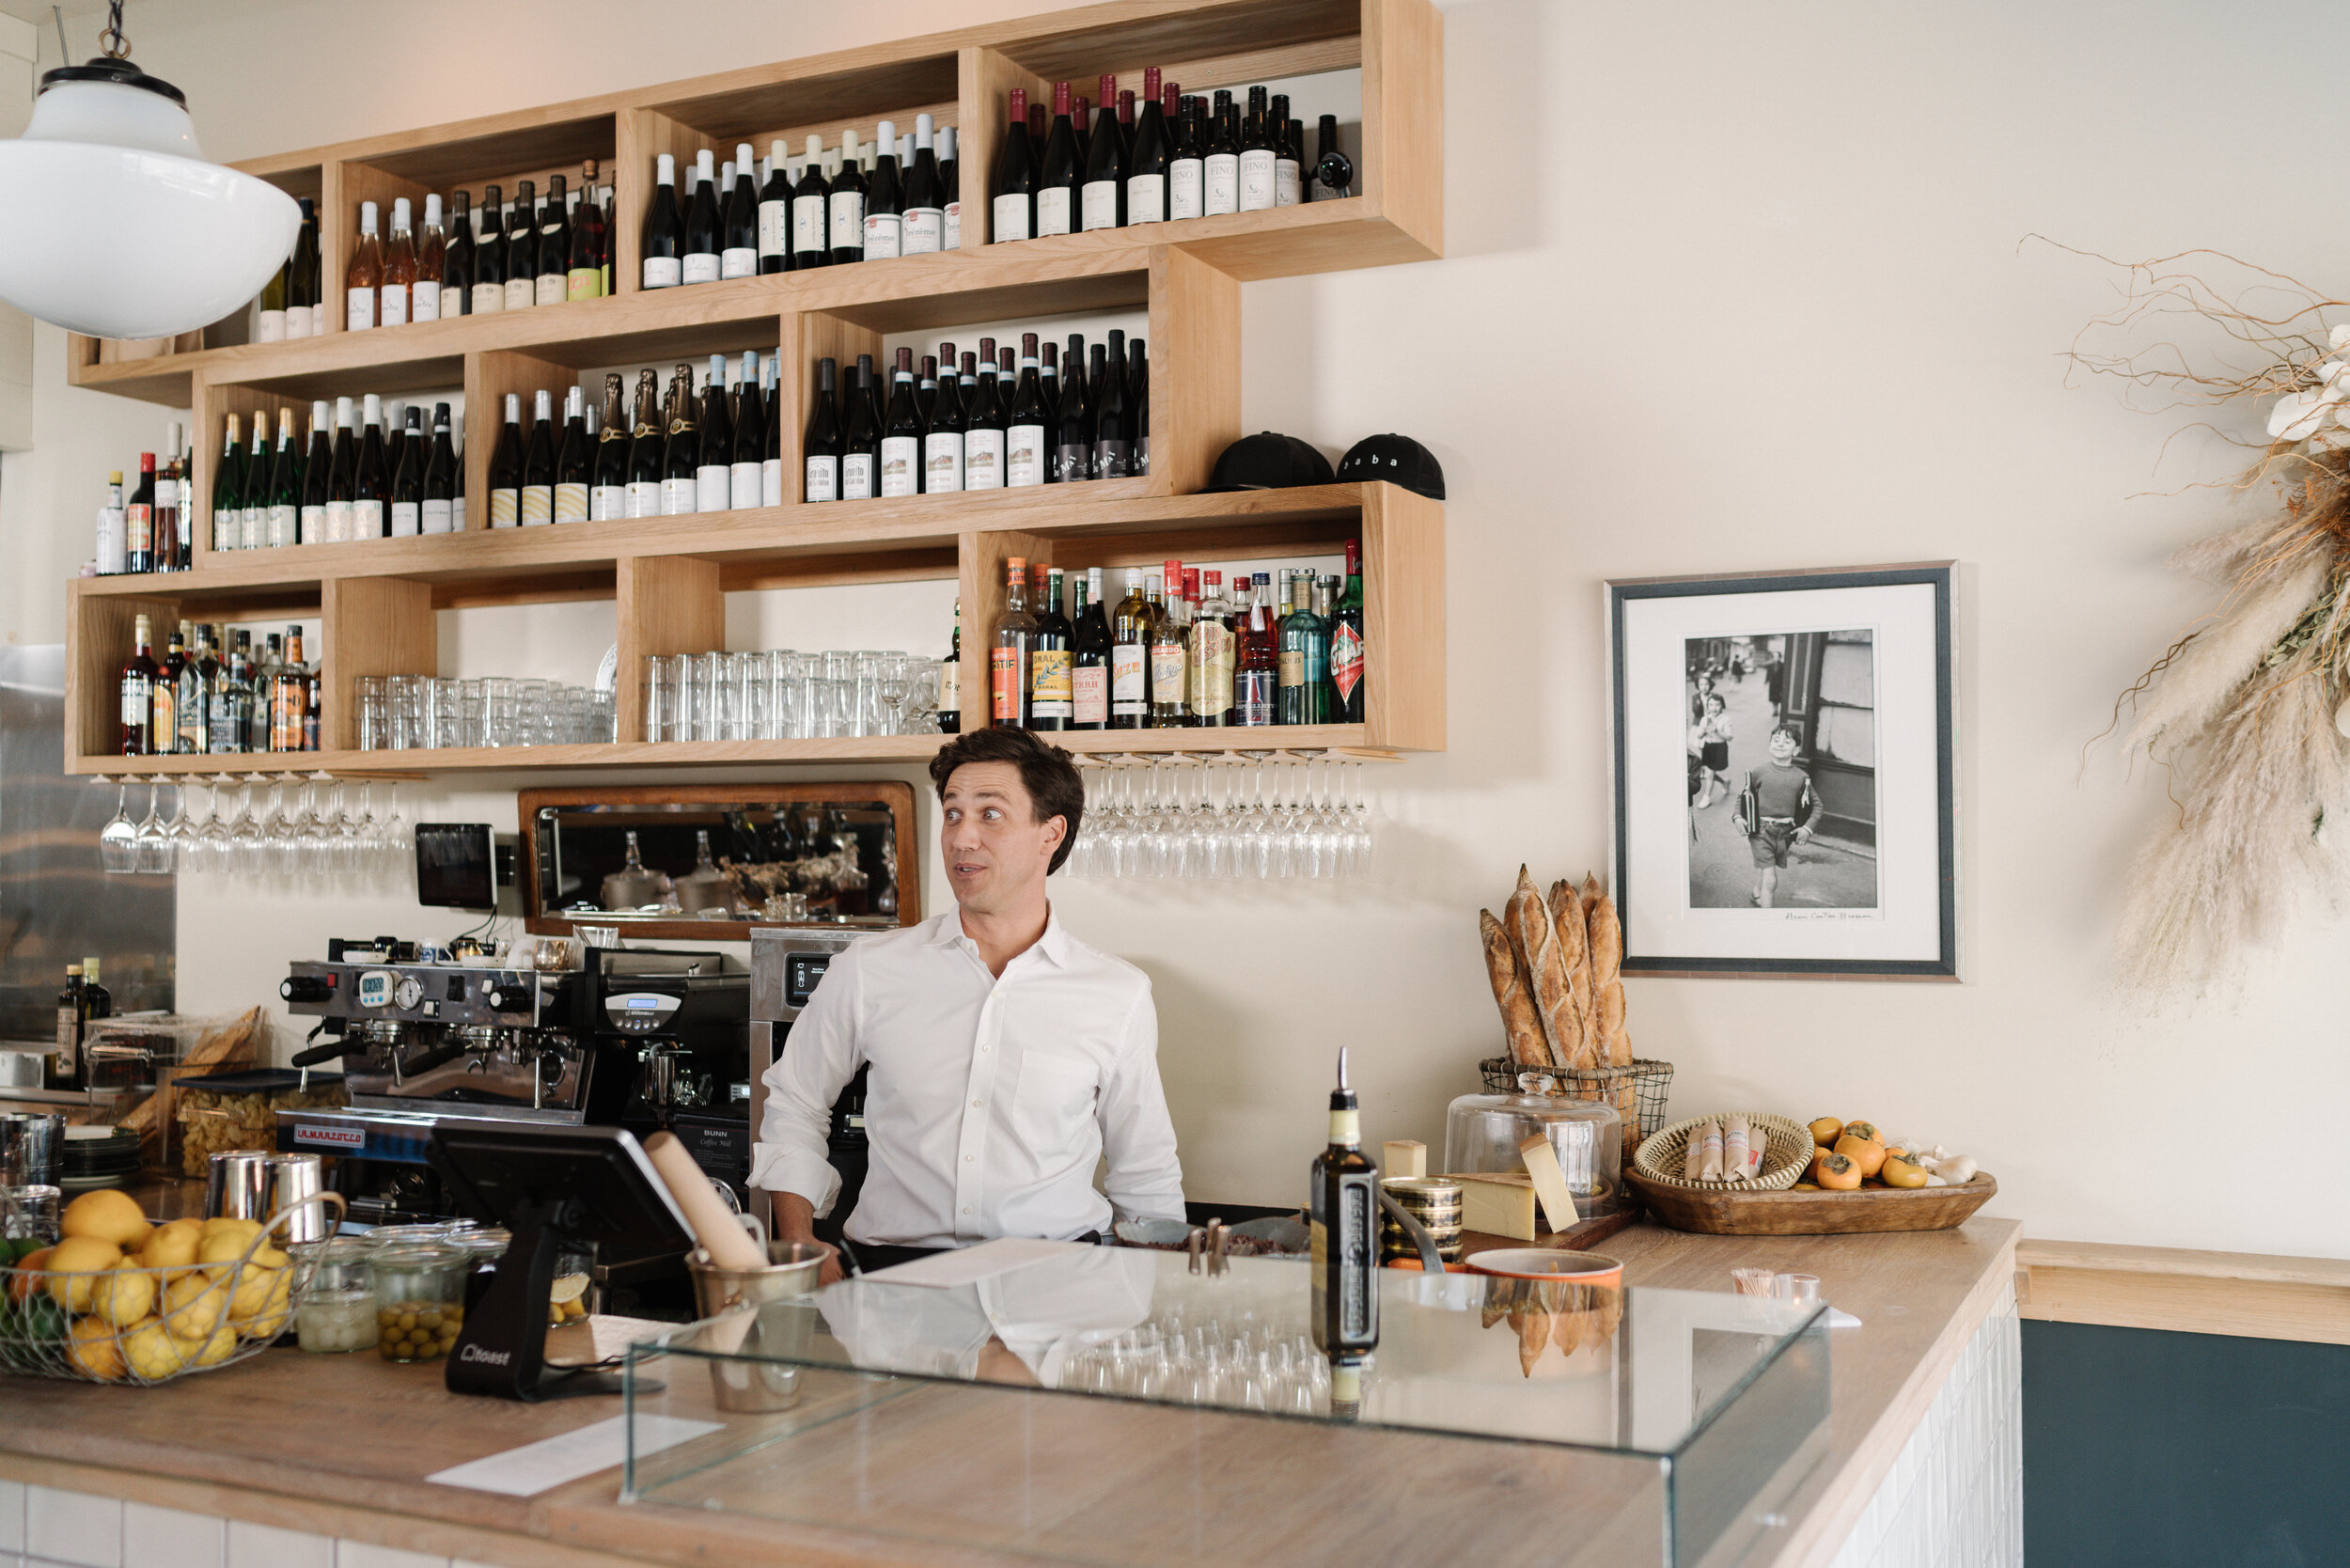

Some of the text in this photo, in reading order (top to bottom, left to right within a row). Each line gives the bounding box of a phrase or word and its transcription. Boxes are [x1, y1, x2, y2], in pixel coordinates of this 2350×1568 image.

[1211, 165, 1233, 177] FINO
[1245, 162, 1267, 172] FINO
[1172, 170, 1194, 182] FINO
[704, 1129, 728, 1137] BUNN
[475, 1347, 511, 1366] toast
